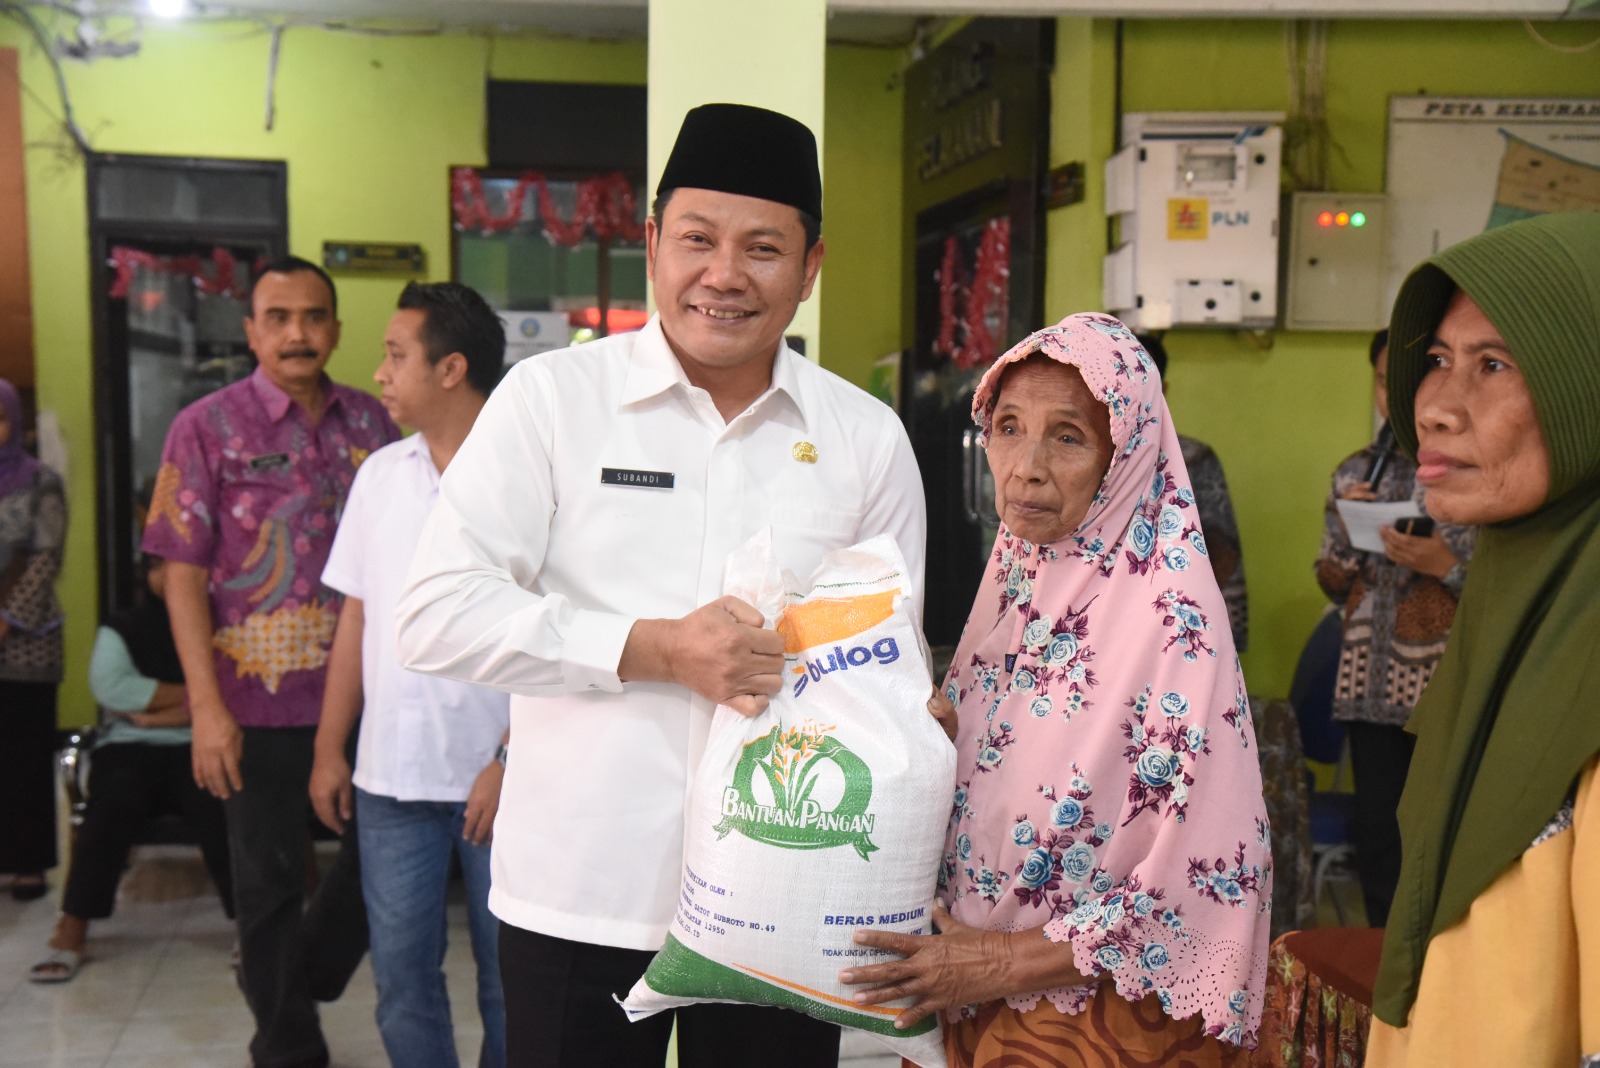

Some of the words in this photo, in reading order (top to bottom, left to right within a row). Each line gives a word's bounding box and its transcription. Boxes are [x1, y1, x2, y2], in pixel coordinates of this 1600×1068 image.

[1424, 102, 1485, 116] PETA
[1211, 210, 1250, 227] PLN
[616, 472, 660, 484] SUBANDI
[808, 637, 900, 682] bulog
[713, 912, 746, 928] SUBROTO
[749, 921, 776, 933] NO.49
[823, 915, 875, 926] BERAS
[878, 906, 925, 925] MEDIUM
[704, 921, 726, 936] 12950
[822, 948, 844, 957] TIDAK
[844, 949, 869, 957] UNTUK
